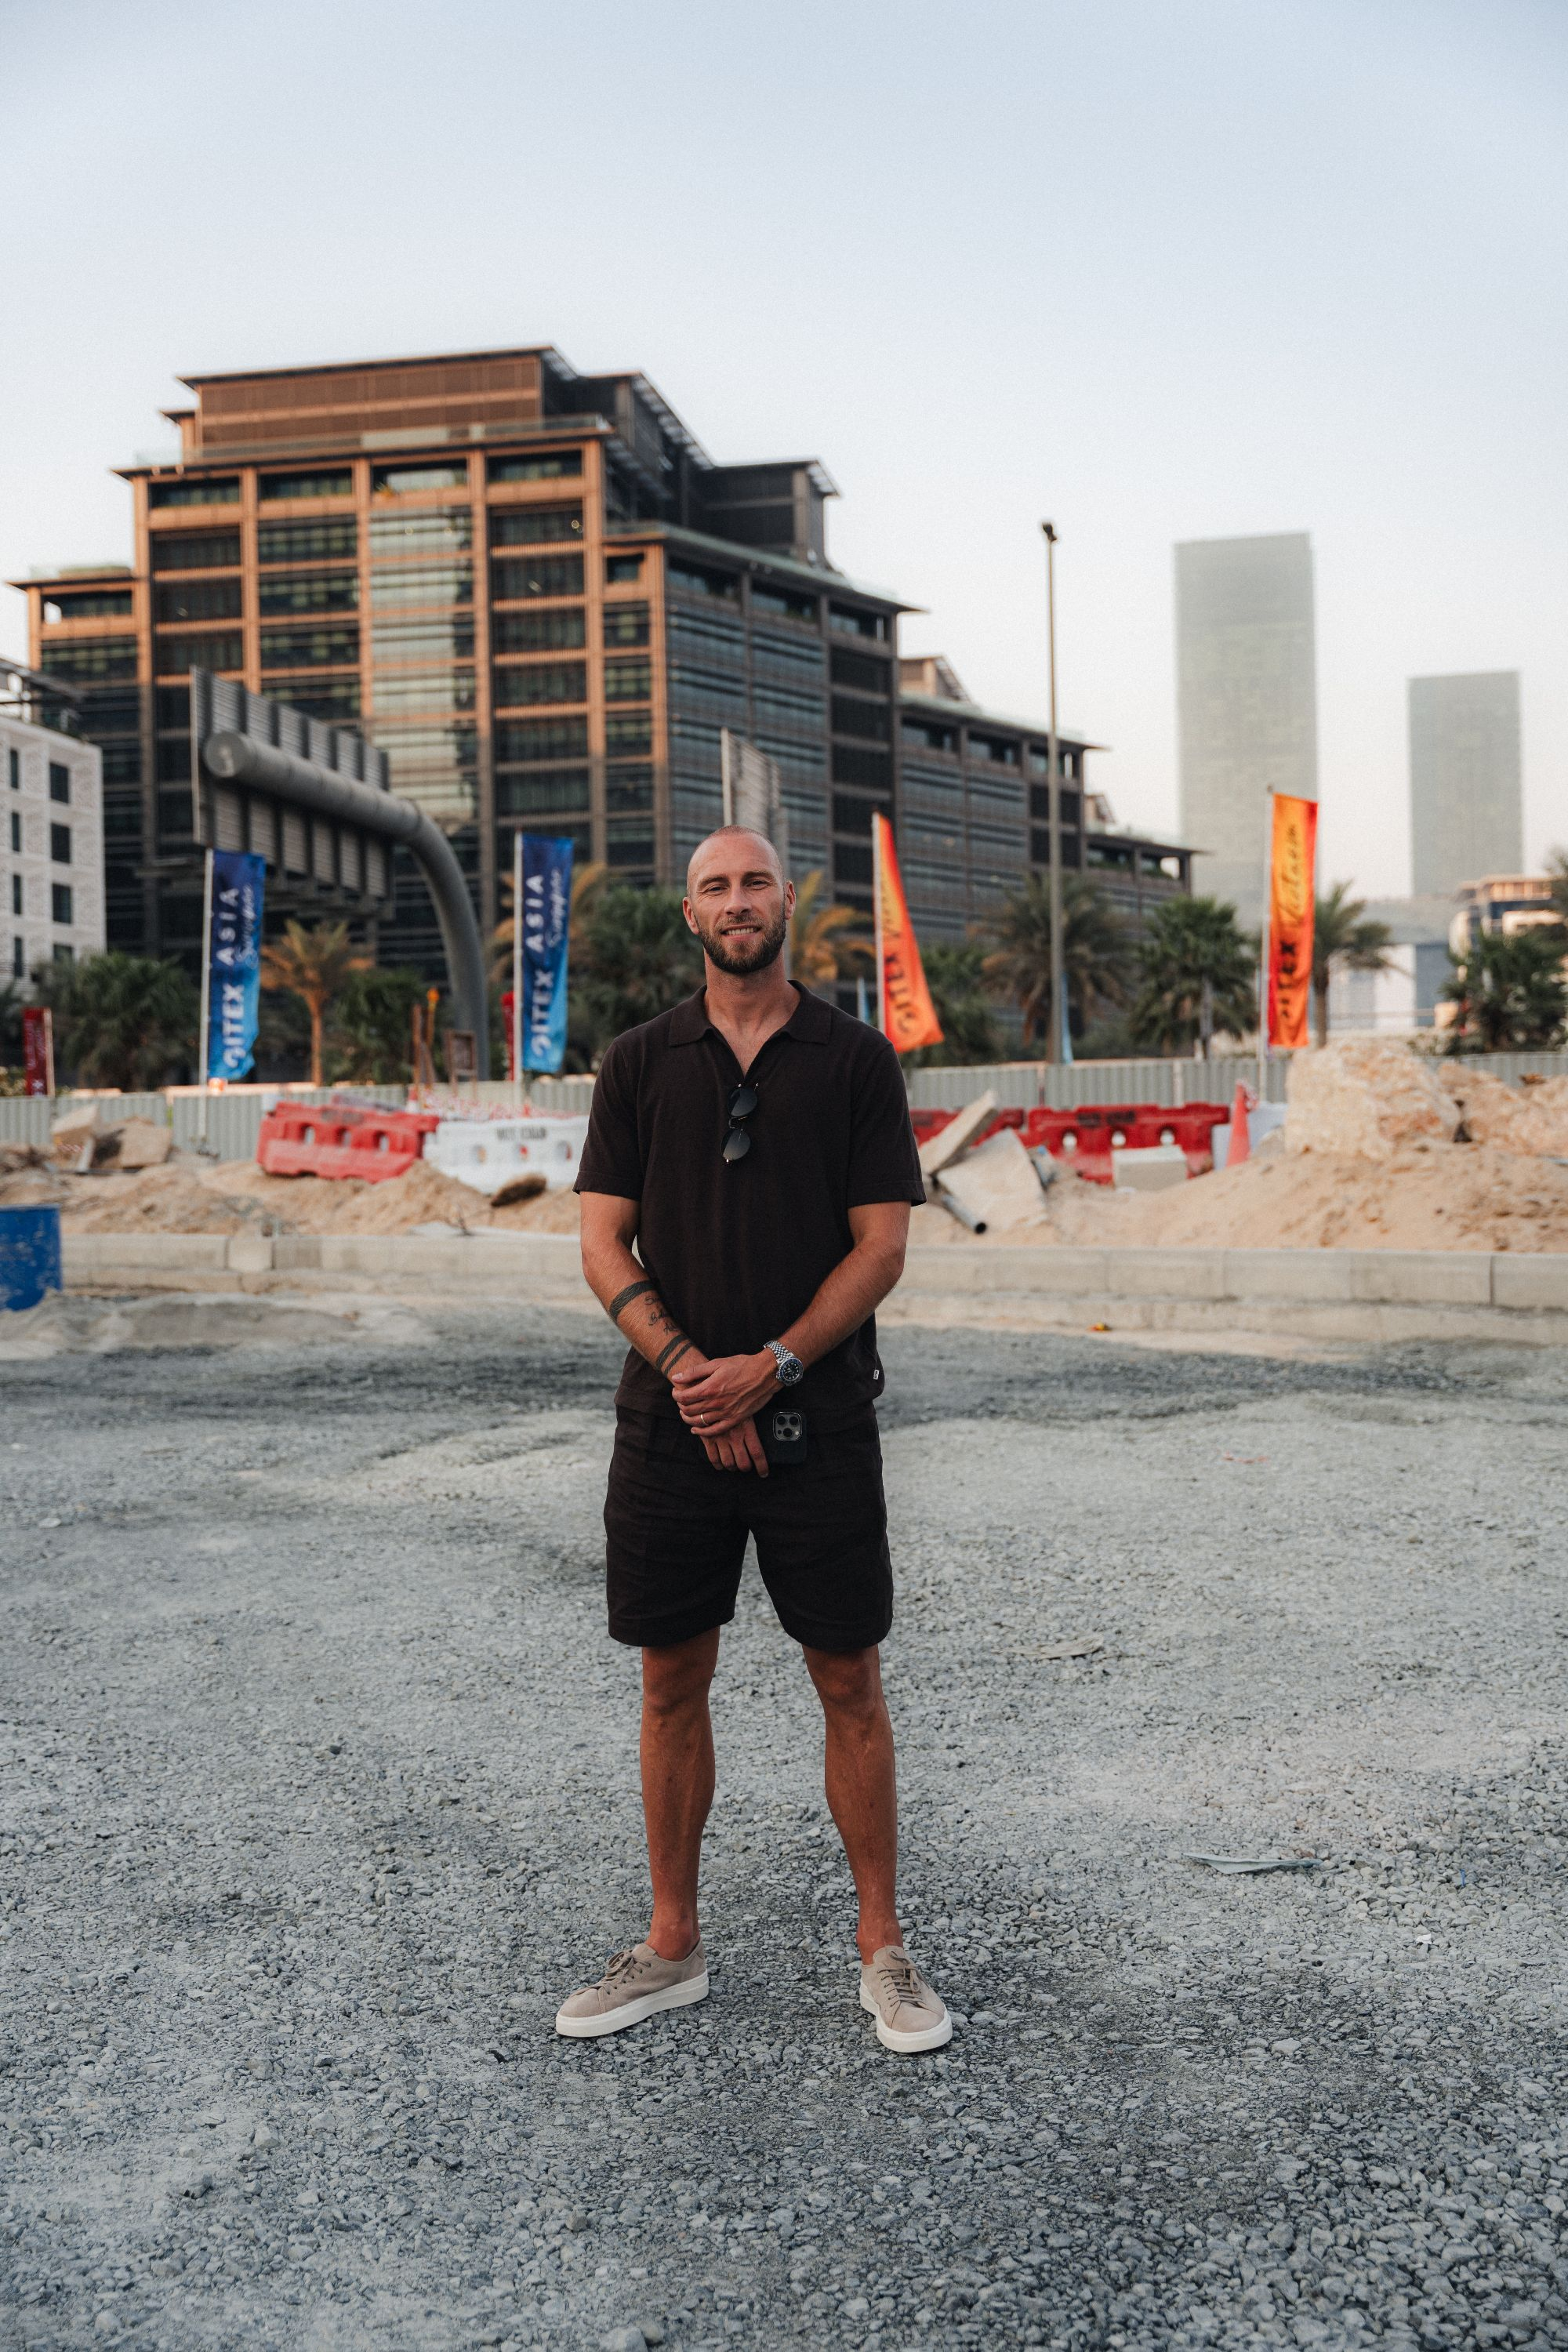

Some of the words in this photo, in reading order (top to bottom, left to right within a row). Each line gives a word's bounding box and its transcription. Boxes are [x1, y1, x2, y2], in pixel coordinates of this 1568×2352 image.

[216, 888, 239, 966] ASIA
[525, 875, 544, 953] ASIA
[223, 983, 245, 1068] GITEX
[531, 970, 554, 1056] GITEX
